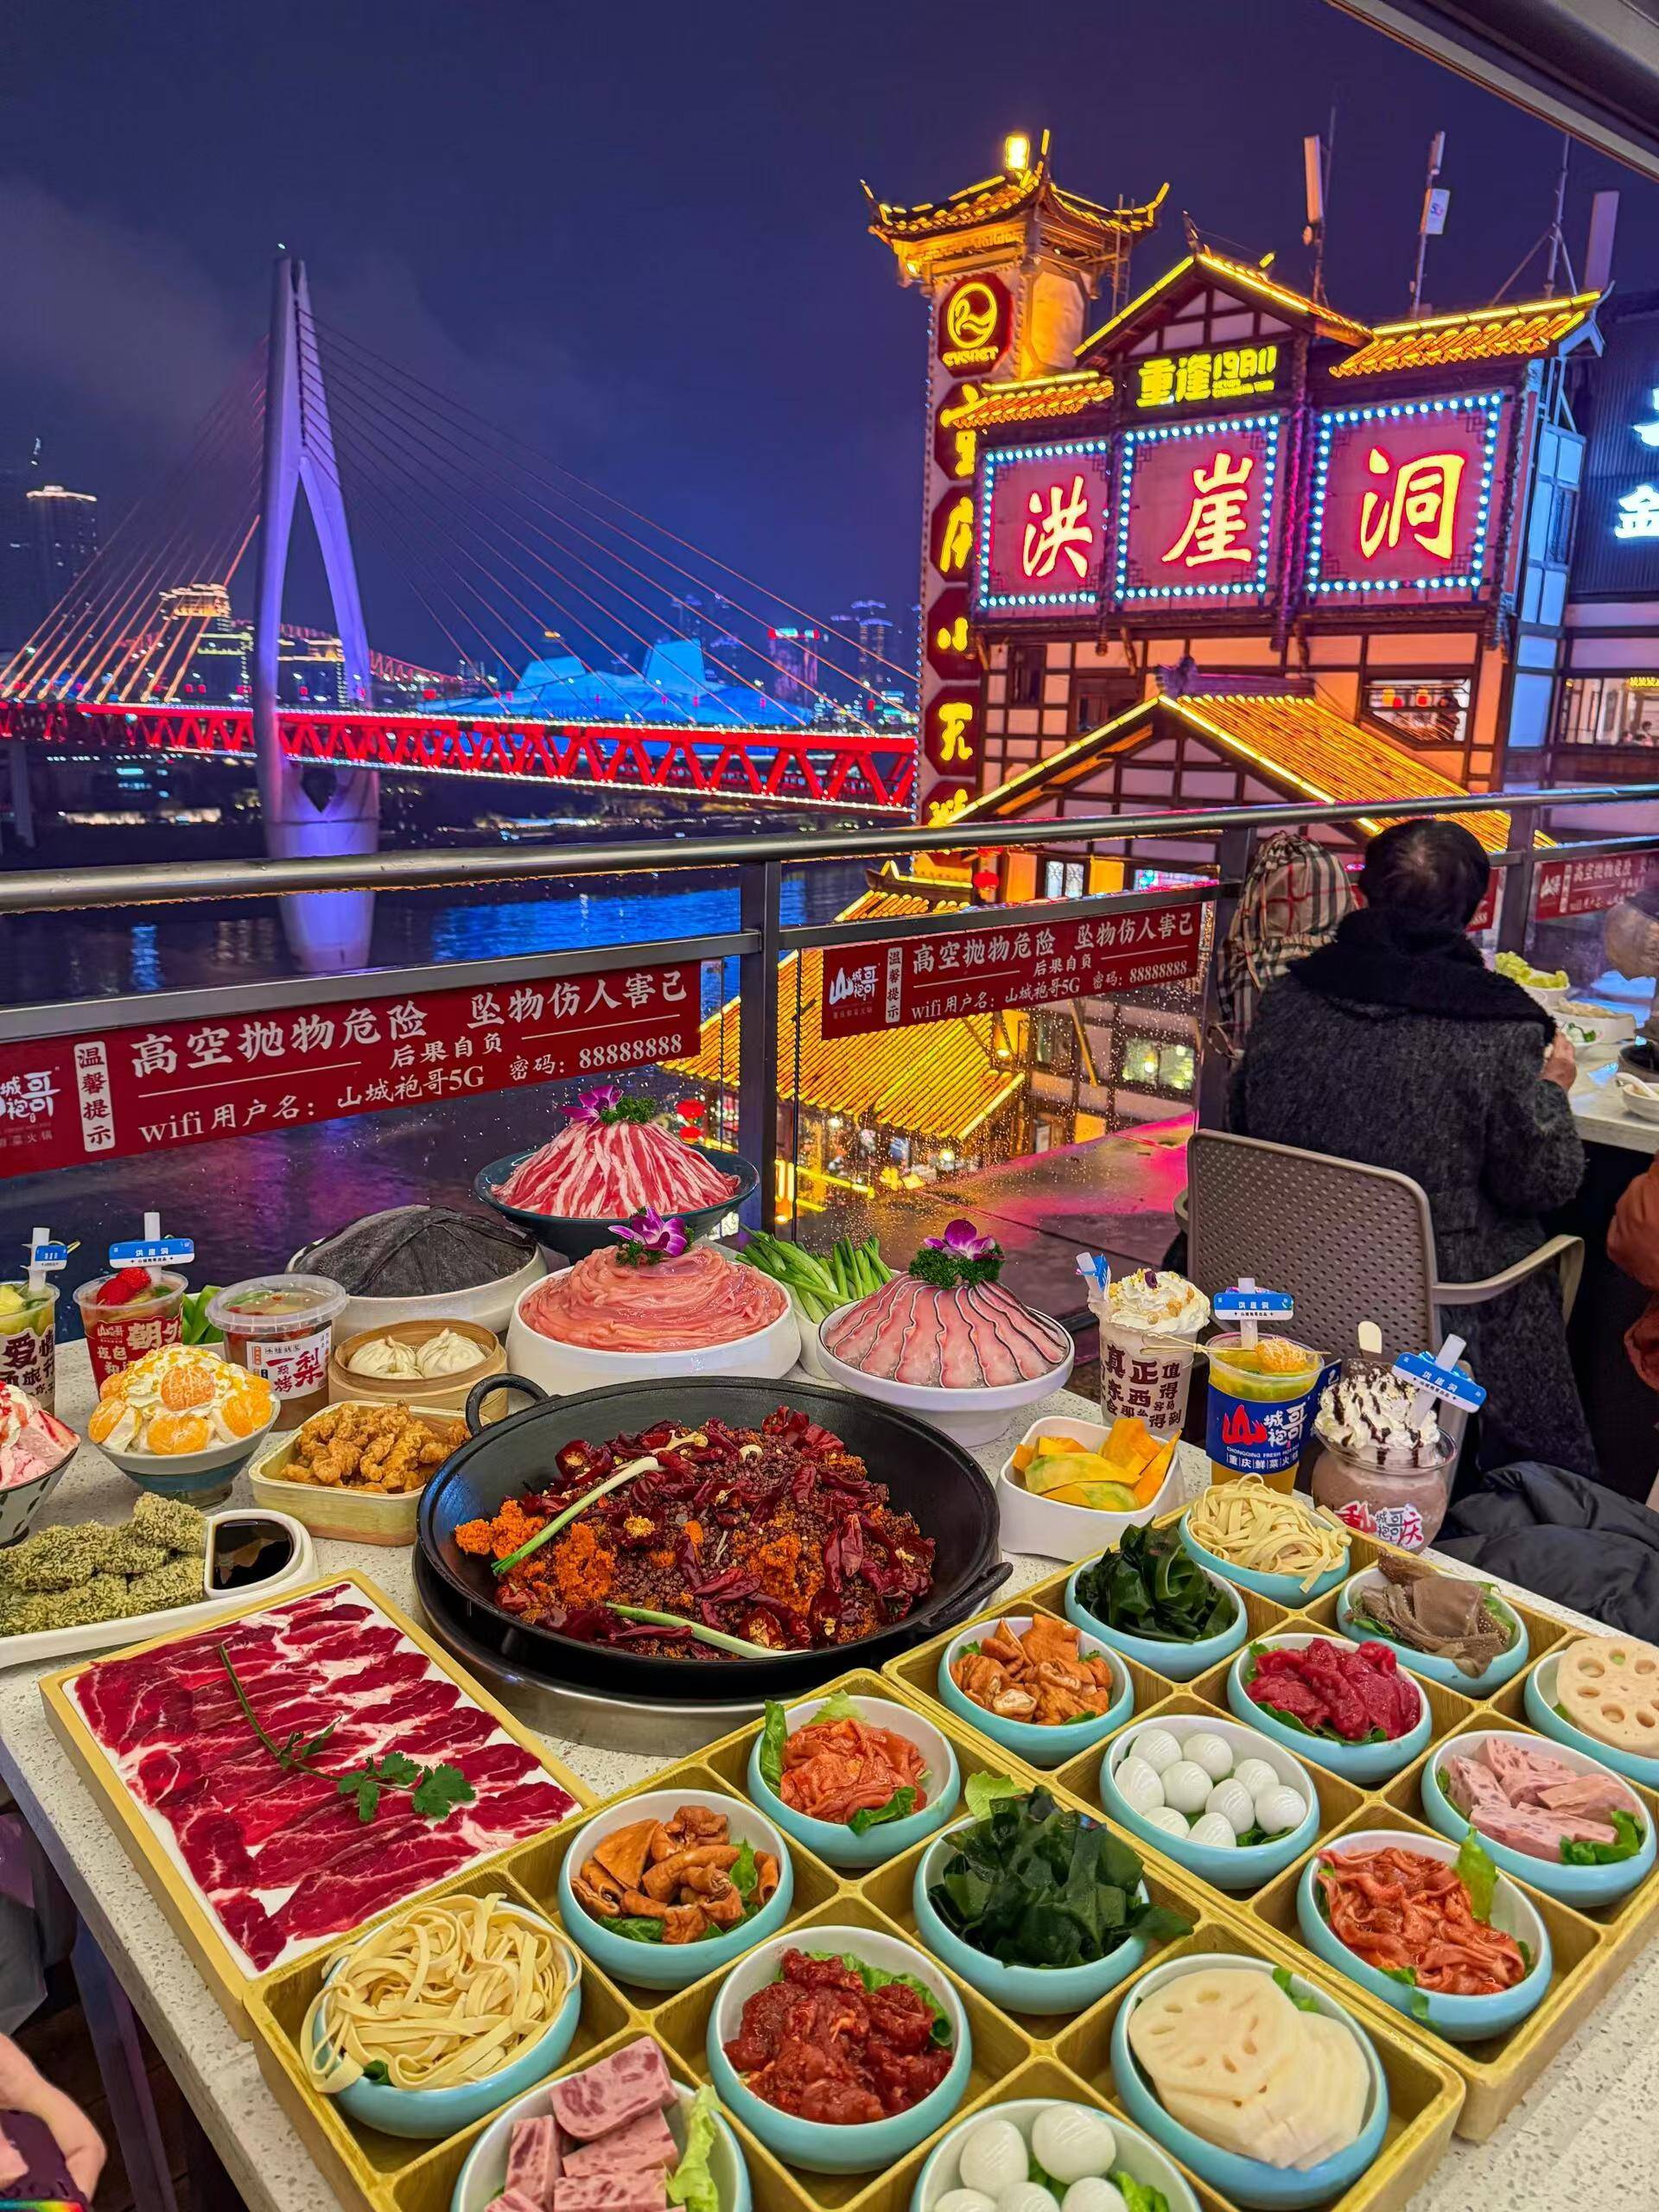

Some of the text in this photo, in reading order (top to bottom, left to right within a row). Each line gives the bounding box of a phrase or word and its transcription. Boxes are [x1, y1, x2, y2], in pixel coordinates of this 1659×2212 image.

[1022, 448, 1465, 578] 洪崖洞
[912, 912, 1194, 975] 高空抛物危险 坠物伤人害己
[1033, 952, 1092, 977] 后果自负
[130, 970, 687, 1079] 高空抛物危险 坠物伤人害己
[389, 1033, 503, 1071] 后果自负
[579, 1033, 683, 1069] 88888888
[0, 1071, 60, 1122] 城袍哥
[76, 1046, 111, 1146] 温馨提示
[1222, 1402, 1307, 1448] 山城袍哥
